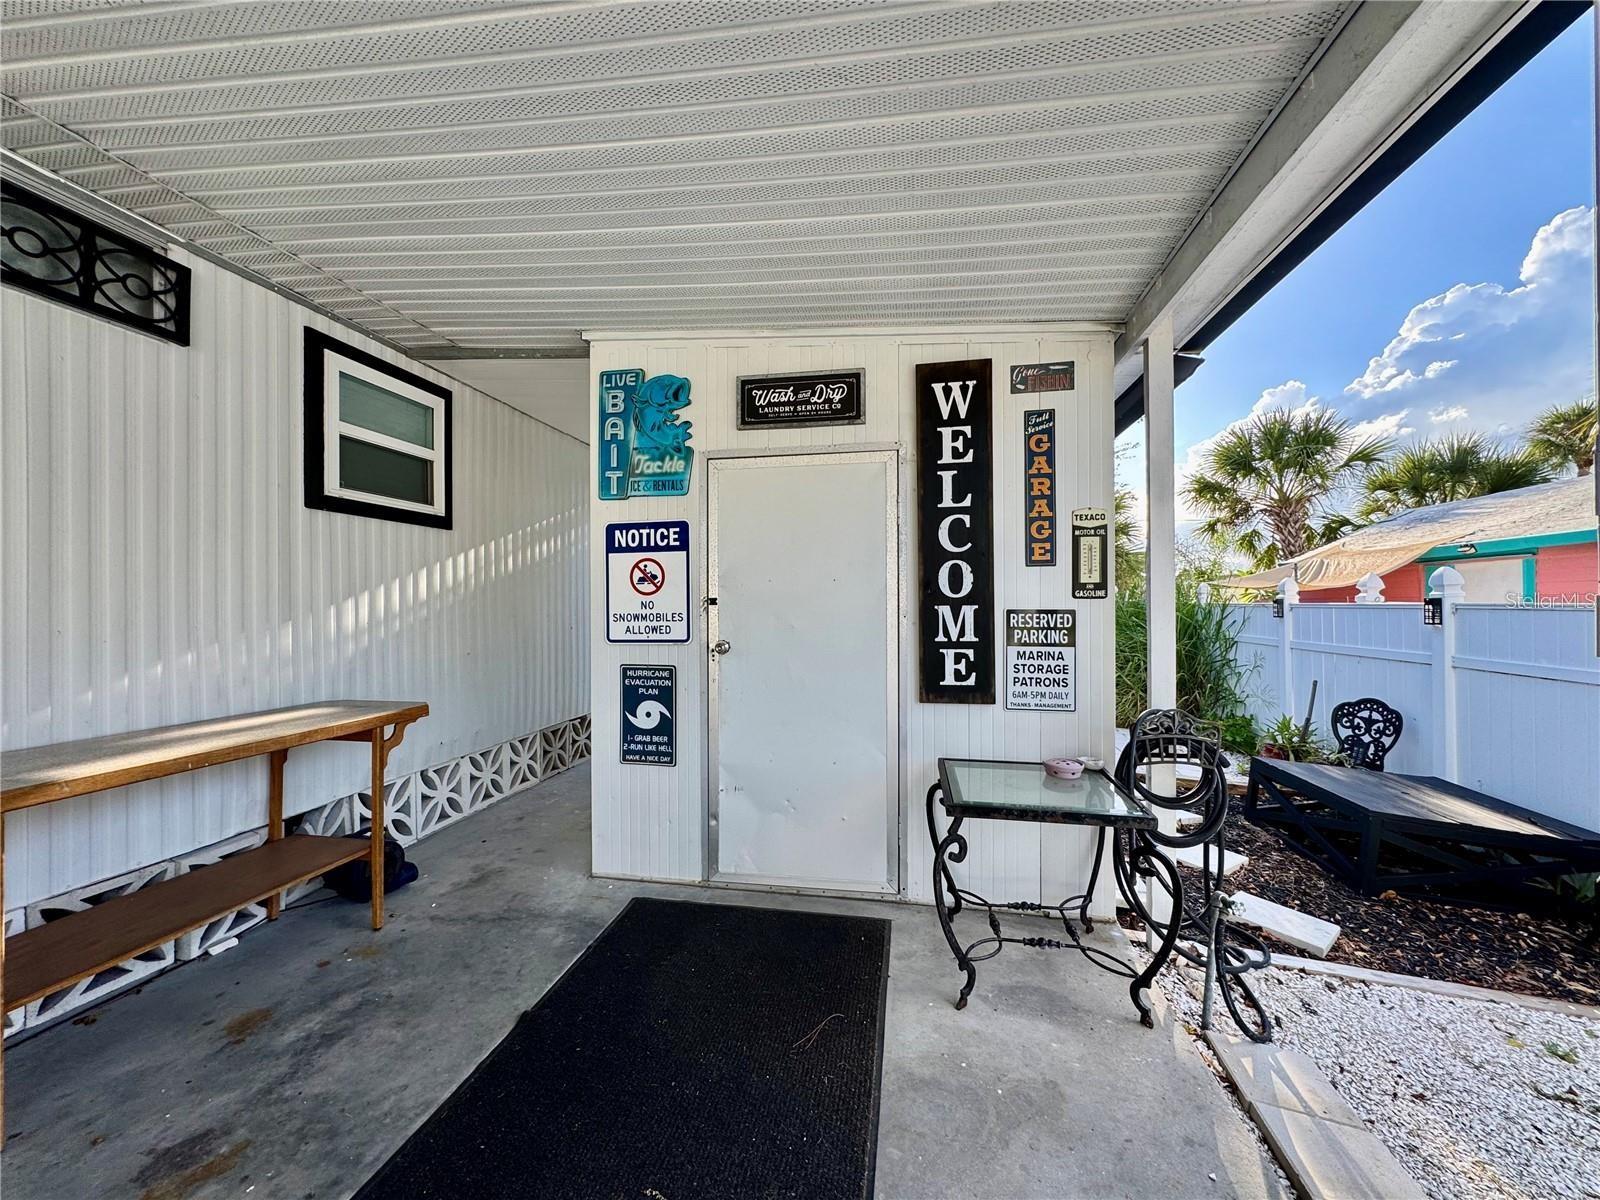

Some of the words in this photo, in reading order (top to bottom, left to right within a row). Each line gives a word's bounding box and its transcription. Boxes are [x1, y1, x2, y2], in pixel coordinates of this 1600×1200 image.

[602, 373, 636, 388] LIVE
[1012, 366, 1047, 384] Gone
[752, 385, 796, 406] Wash
[797, 390, 812, 400] and
[810, 383, 847, 403] Dry
[759, 405, 795, 414] LAUNDRY
[796, 403, 830, 412] SERVICE
[1028, 412, 1049, 425] Full
[1025, 421, 1053, 434] Service
[604, 389, 625, 495] BAIT
[634, 454, 685, 474] Tackle
[630, 480, 641, 492] ICE
[642, 481, 652, 492] &
[652, 480, 684, 491] RENTALS
[1028, 433, 1051, 561] GARAGE
[1074, 513, 1106, 521] TEXACO
[614, 528, 680, 548] NOTICE
[931, 380, 979, 686] WELCOME
[1075, 589, 1106, 597] GASOLINE
[640, 600, 655, 610] NO
[612, 612, 684, 623] SNOWMOBILES
[1010, 613, 1072, 628] RESERVED
[625, 625, 671, 635] ALLOWED
[1014, 629, 1068, 644] PARKING
[1016, 650, 1065, 661] MARINA
[626, 669, 670, 678] HURRICANE
[1013, 663, 1069, 675] STORAGE
[625, 678, 672, 687] EVACUATION
[1013, 676, 1069, 688] PATRONS
[1012, 690, 1047, 699] 6AM-5PM
[1048, 691, 1070, 700] DAILY
[634, 734, 651, 742] GRAB
[652, 735, 668, 743] BEER
[644, 743, 657, 752] LIKE
[658, 744, 672, 753] HELL
